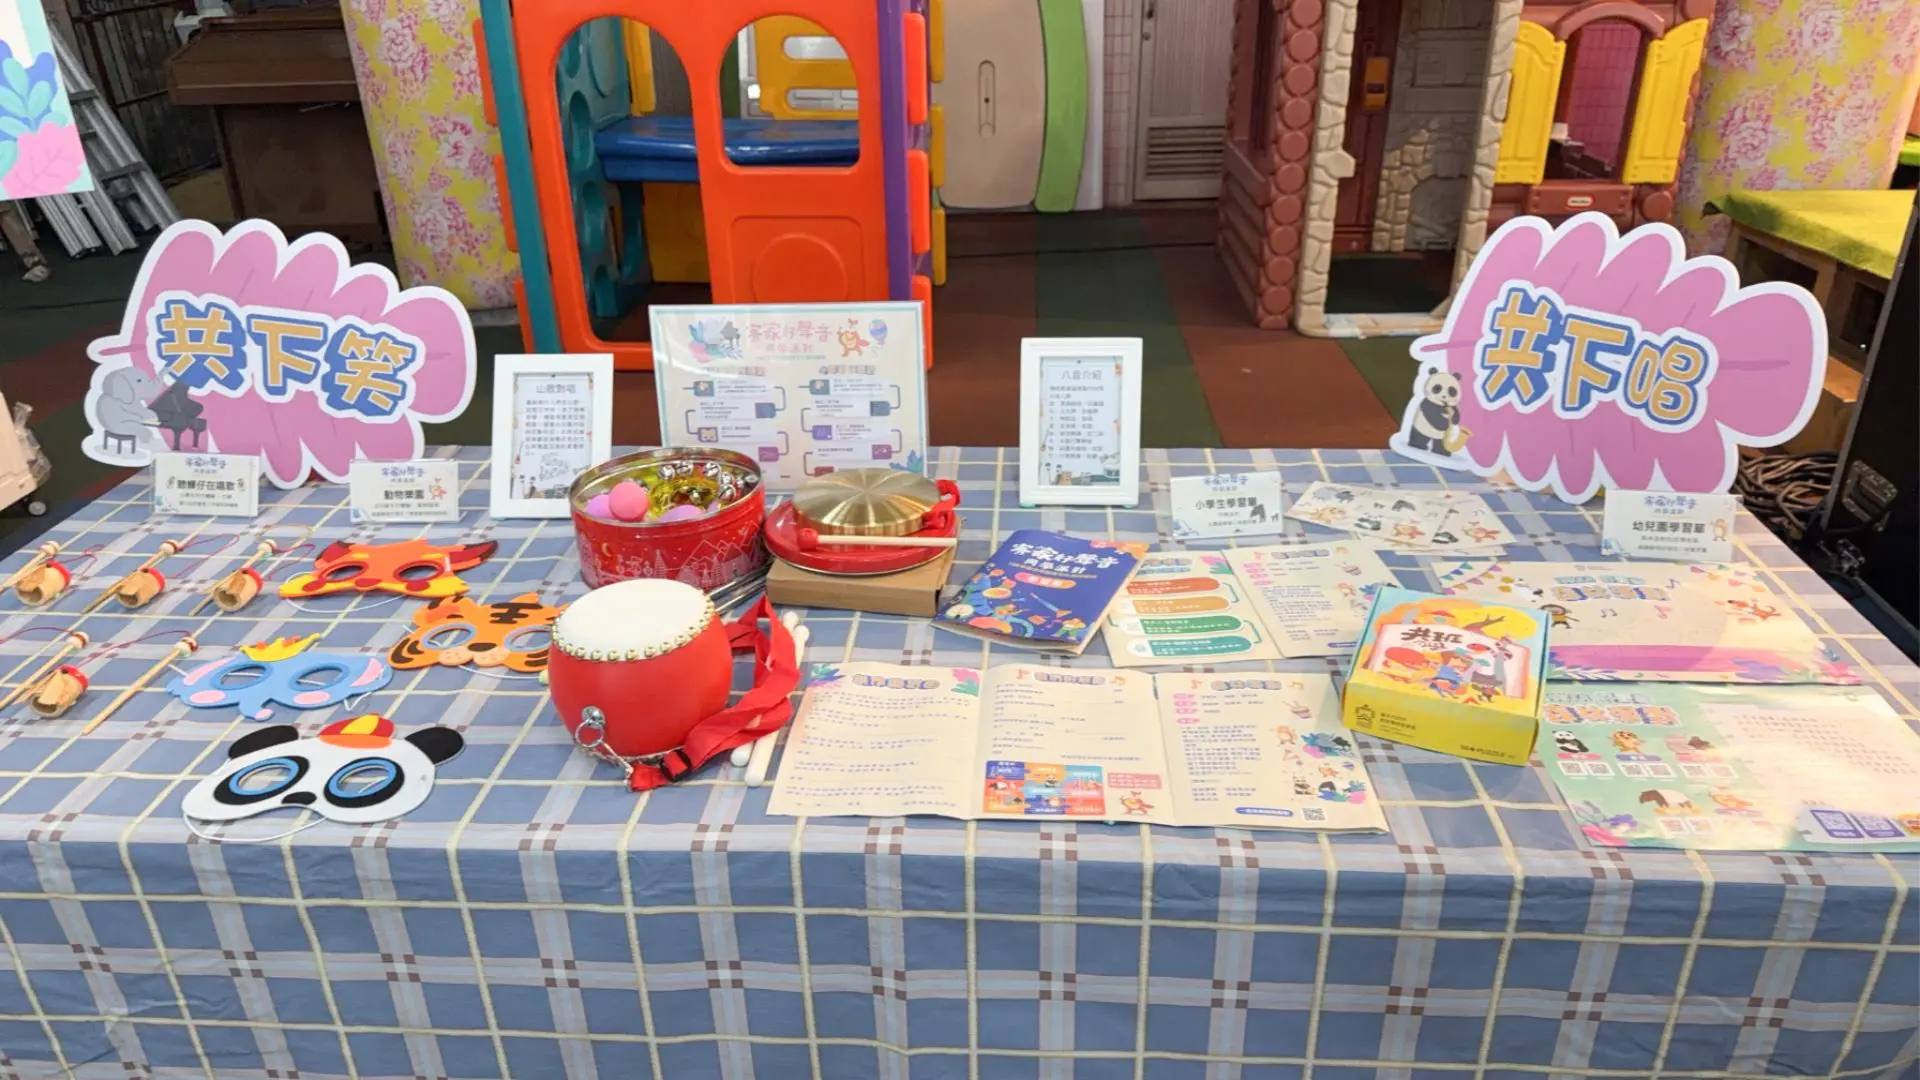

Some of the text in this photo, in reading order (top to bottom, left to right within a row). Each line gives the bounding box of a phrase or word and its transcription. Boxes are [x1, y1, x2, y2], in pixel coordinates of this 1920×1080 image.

[155, 298, 418, 417] 共下笑
[1481, 287, 1709, 425] 共下唱
[1061, 369, 1102, 380] 八音介紹
[536, 383, 576, 394] 山歌對唱
[384, 490, 424, 500] 動物樂園
[1195, 497, 1257, 510] 小學生學習單
[1631, 520, 1706, 533] 幼兒園學習單
